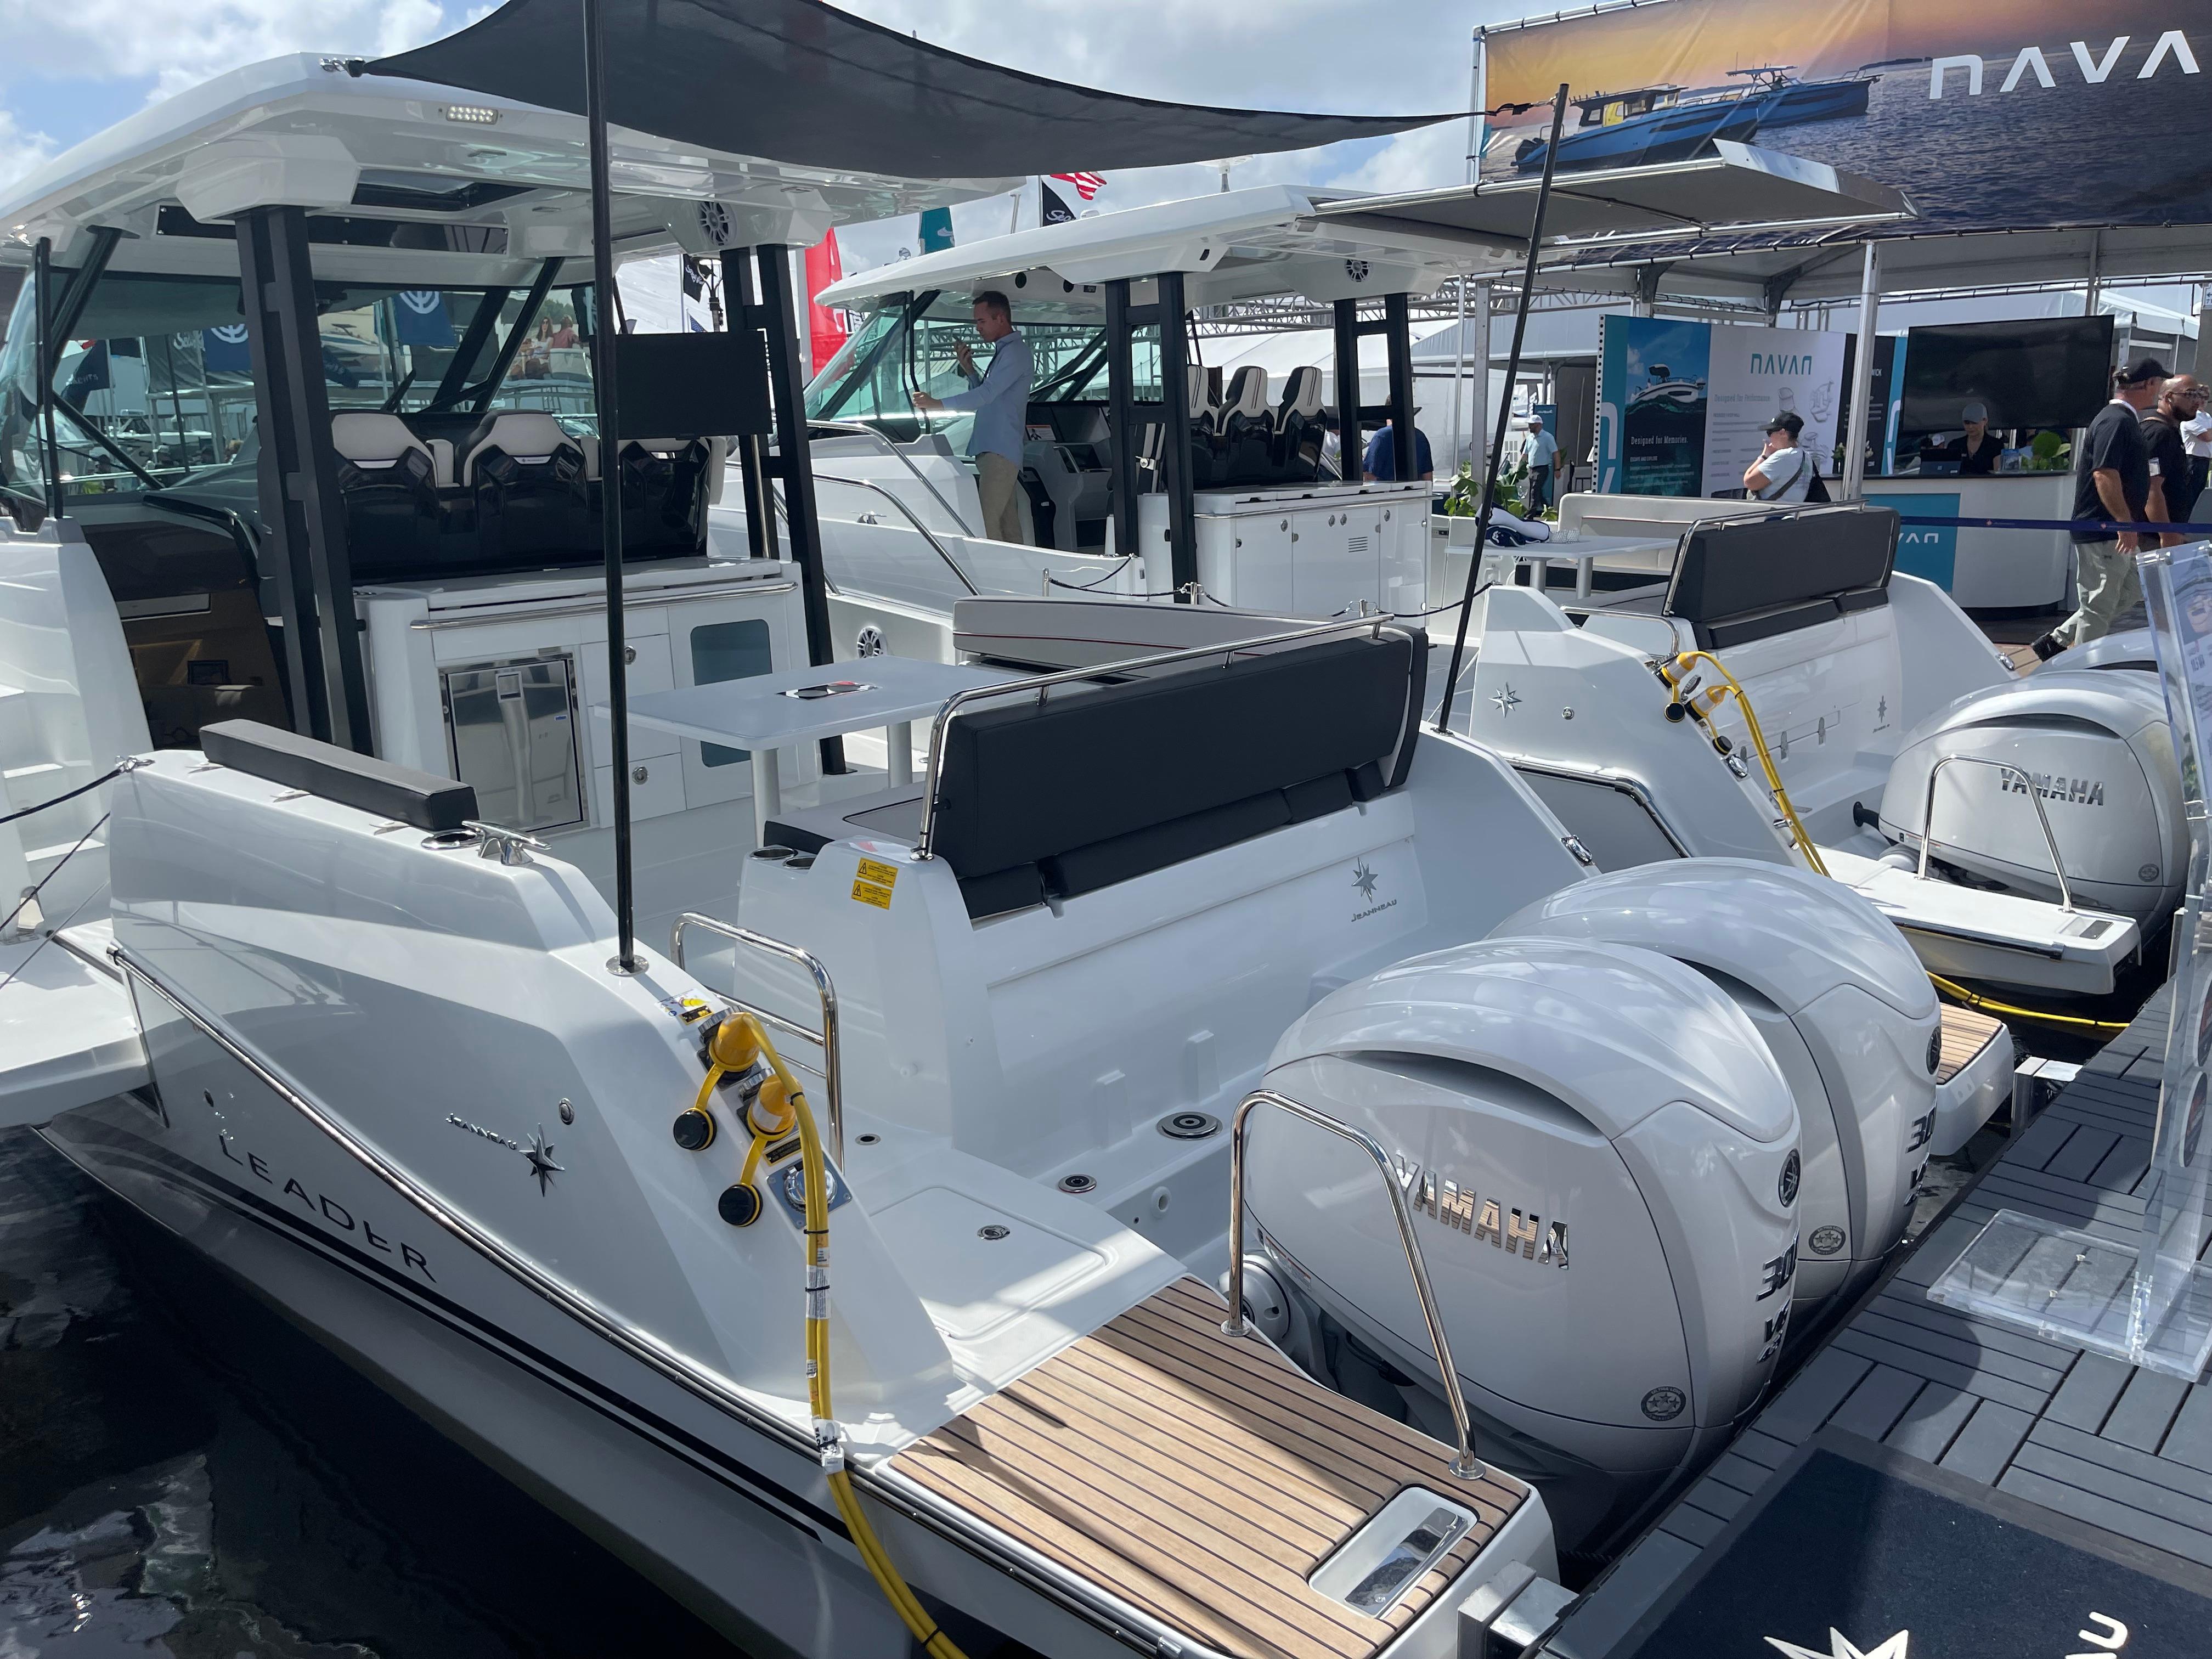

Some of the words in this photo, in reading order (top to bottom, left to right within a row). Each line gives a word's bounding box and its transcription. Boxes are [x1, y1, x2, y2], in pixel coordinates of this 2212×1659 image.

[1750, 353, 1812, 375] NAVAN
[1631, 436, 1654, 447] Designed
[2000, 768, 2103, 806] YAMAHA
[1351, 899, 1398, 922] JEANNEAU
[445, 1113, 517, 1150] JEANNEAU
[1905, 1106, 1937, 1154] 30
[219, 1131, 437, 1284] LEADER
[1396, 1153, 1569, 1271] YAMAHA
[1756, 1228, 1799, 1302] 30
